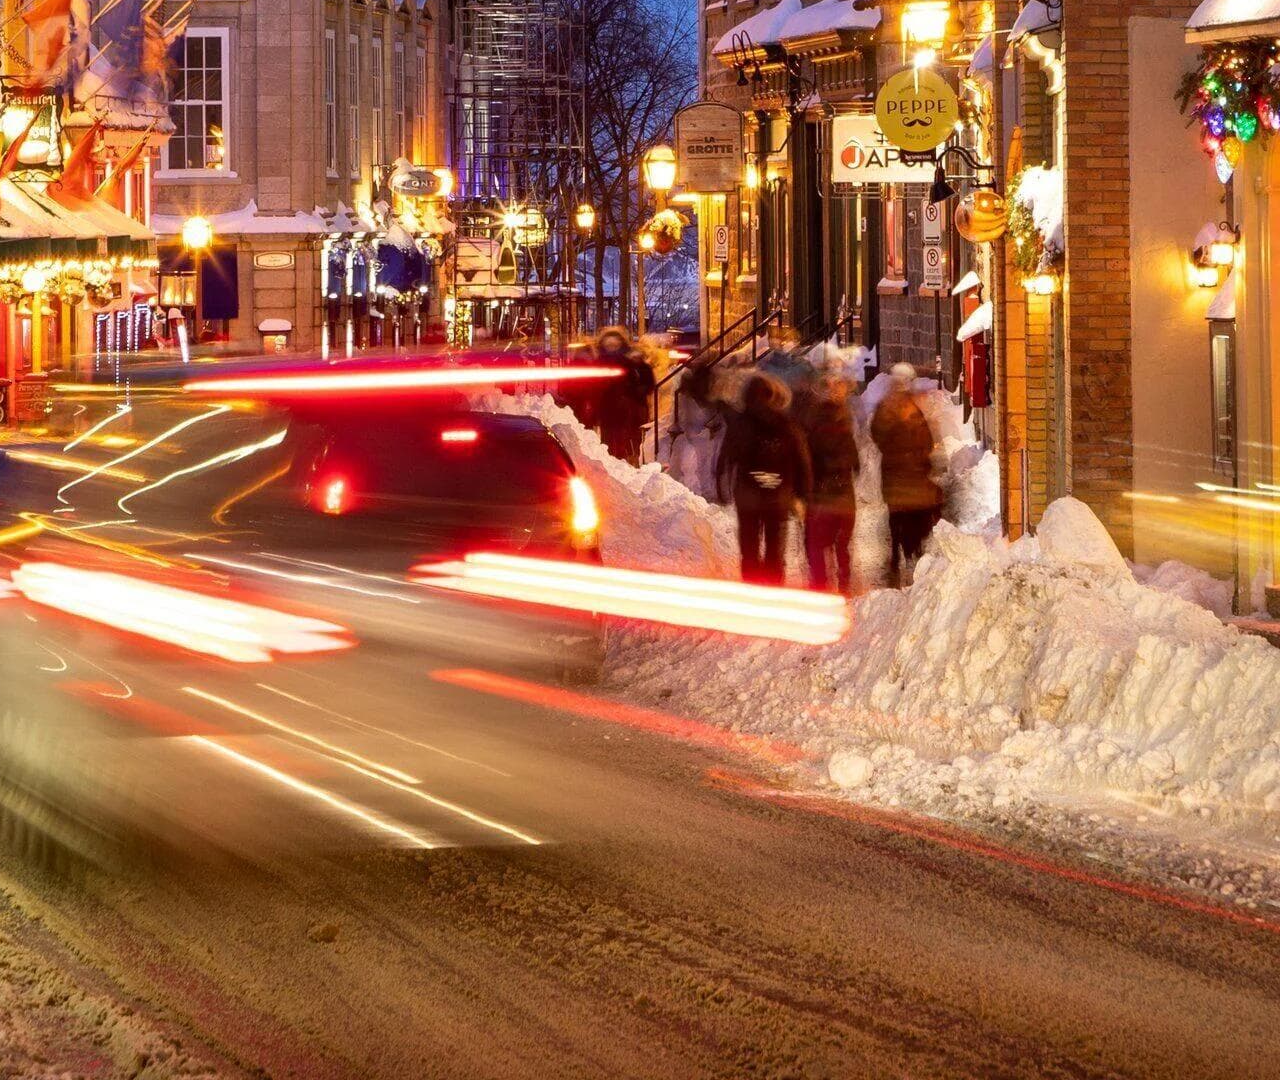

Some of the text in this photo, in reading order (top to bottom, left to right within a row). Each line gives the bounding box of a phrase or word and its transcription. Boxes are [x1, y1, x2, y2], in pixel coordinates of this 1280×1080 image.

[886, 99, 947, 115] PEPPE
[704, 136, 716, 144] LA
[687, 144, 733, 154] GROTTE
